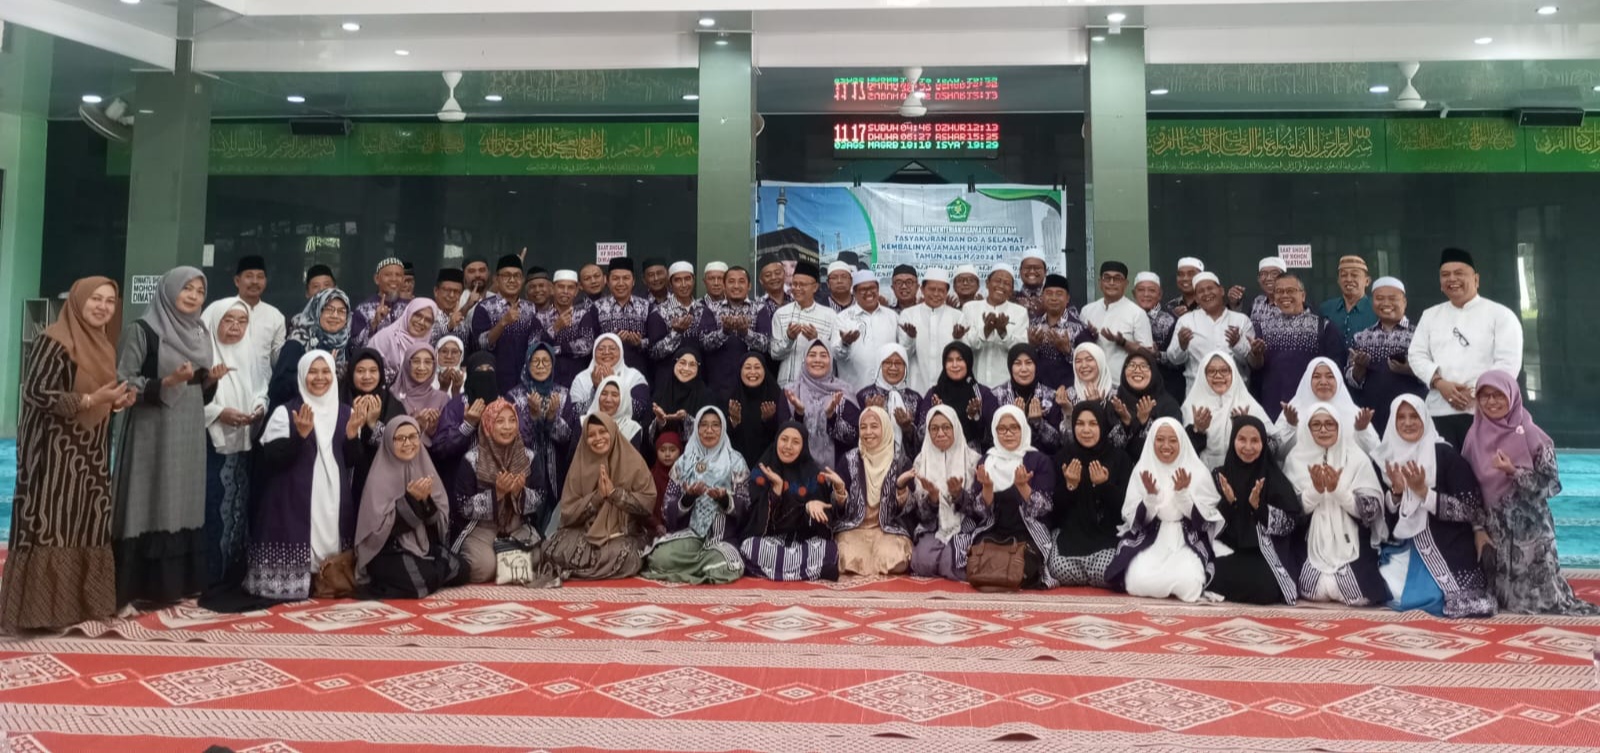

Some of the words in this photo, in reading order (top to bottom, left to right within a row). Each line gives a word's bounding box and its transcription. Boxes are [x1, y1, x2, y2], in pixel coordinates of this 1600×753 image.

[867, 123, 899, 132] SUBUH
[900, 123, 932, 132] 04:46
[966, 123, 999, 132] 12:13
[867, 132, 899, 141] DHUHA
[900, 132, 932, 141] 06:27
[935, 132, 966, 141] ASHAR
[881, 243, 931, 251] KEMBALINYA
